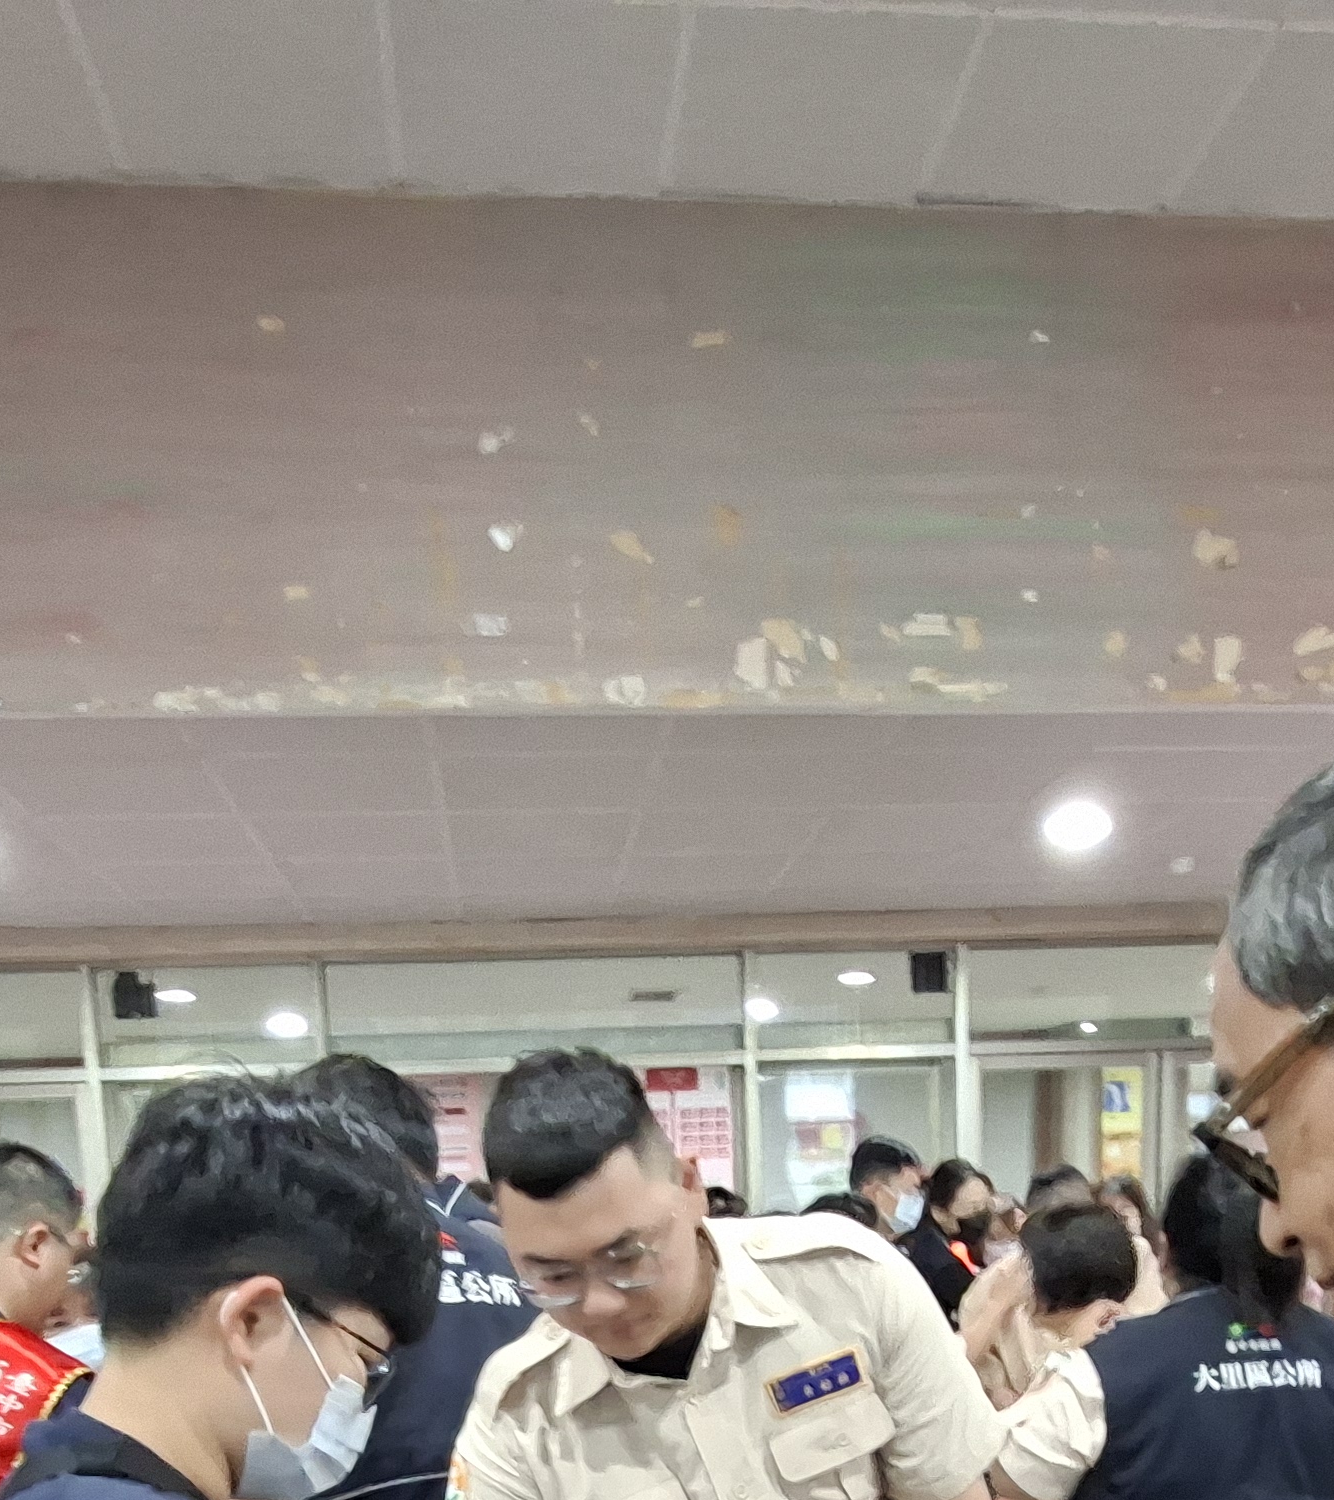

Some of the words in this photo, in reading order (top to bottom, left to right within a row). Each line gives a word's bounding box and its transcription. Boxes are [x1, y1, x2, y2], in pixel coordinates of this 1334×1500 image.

[1193, 1359, 1322, 1393] 大里區公所
